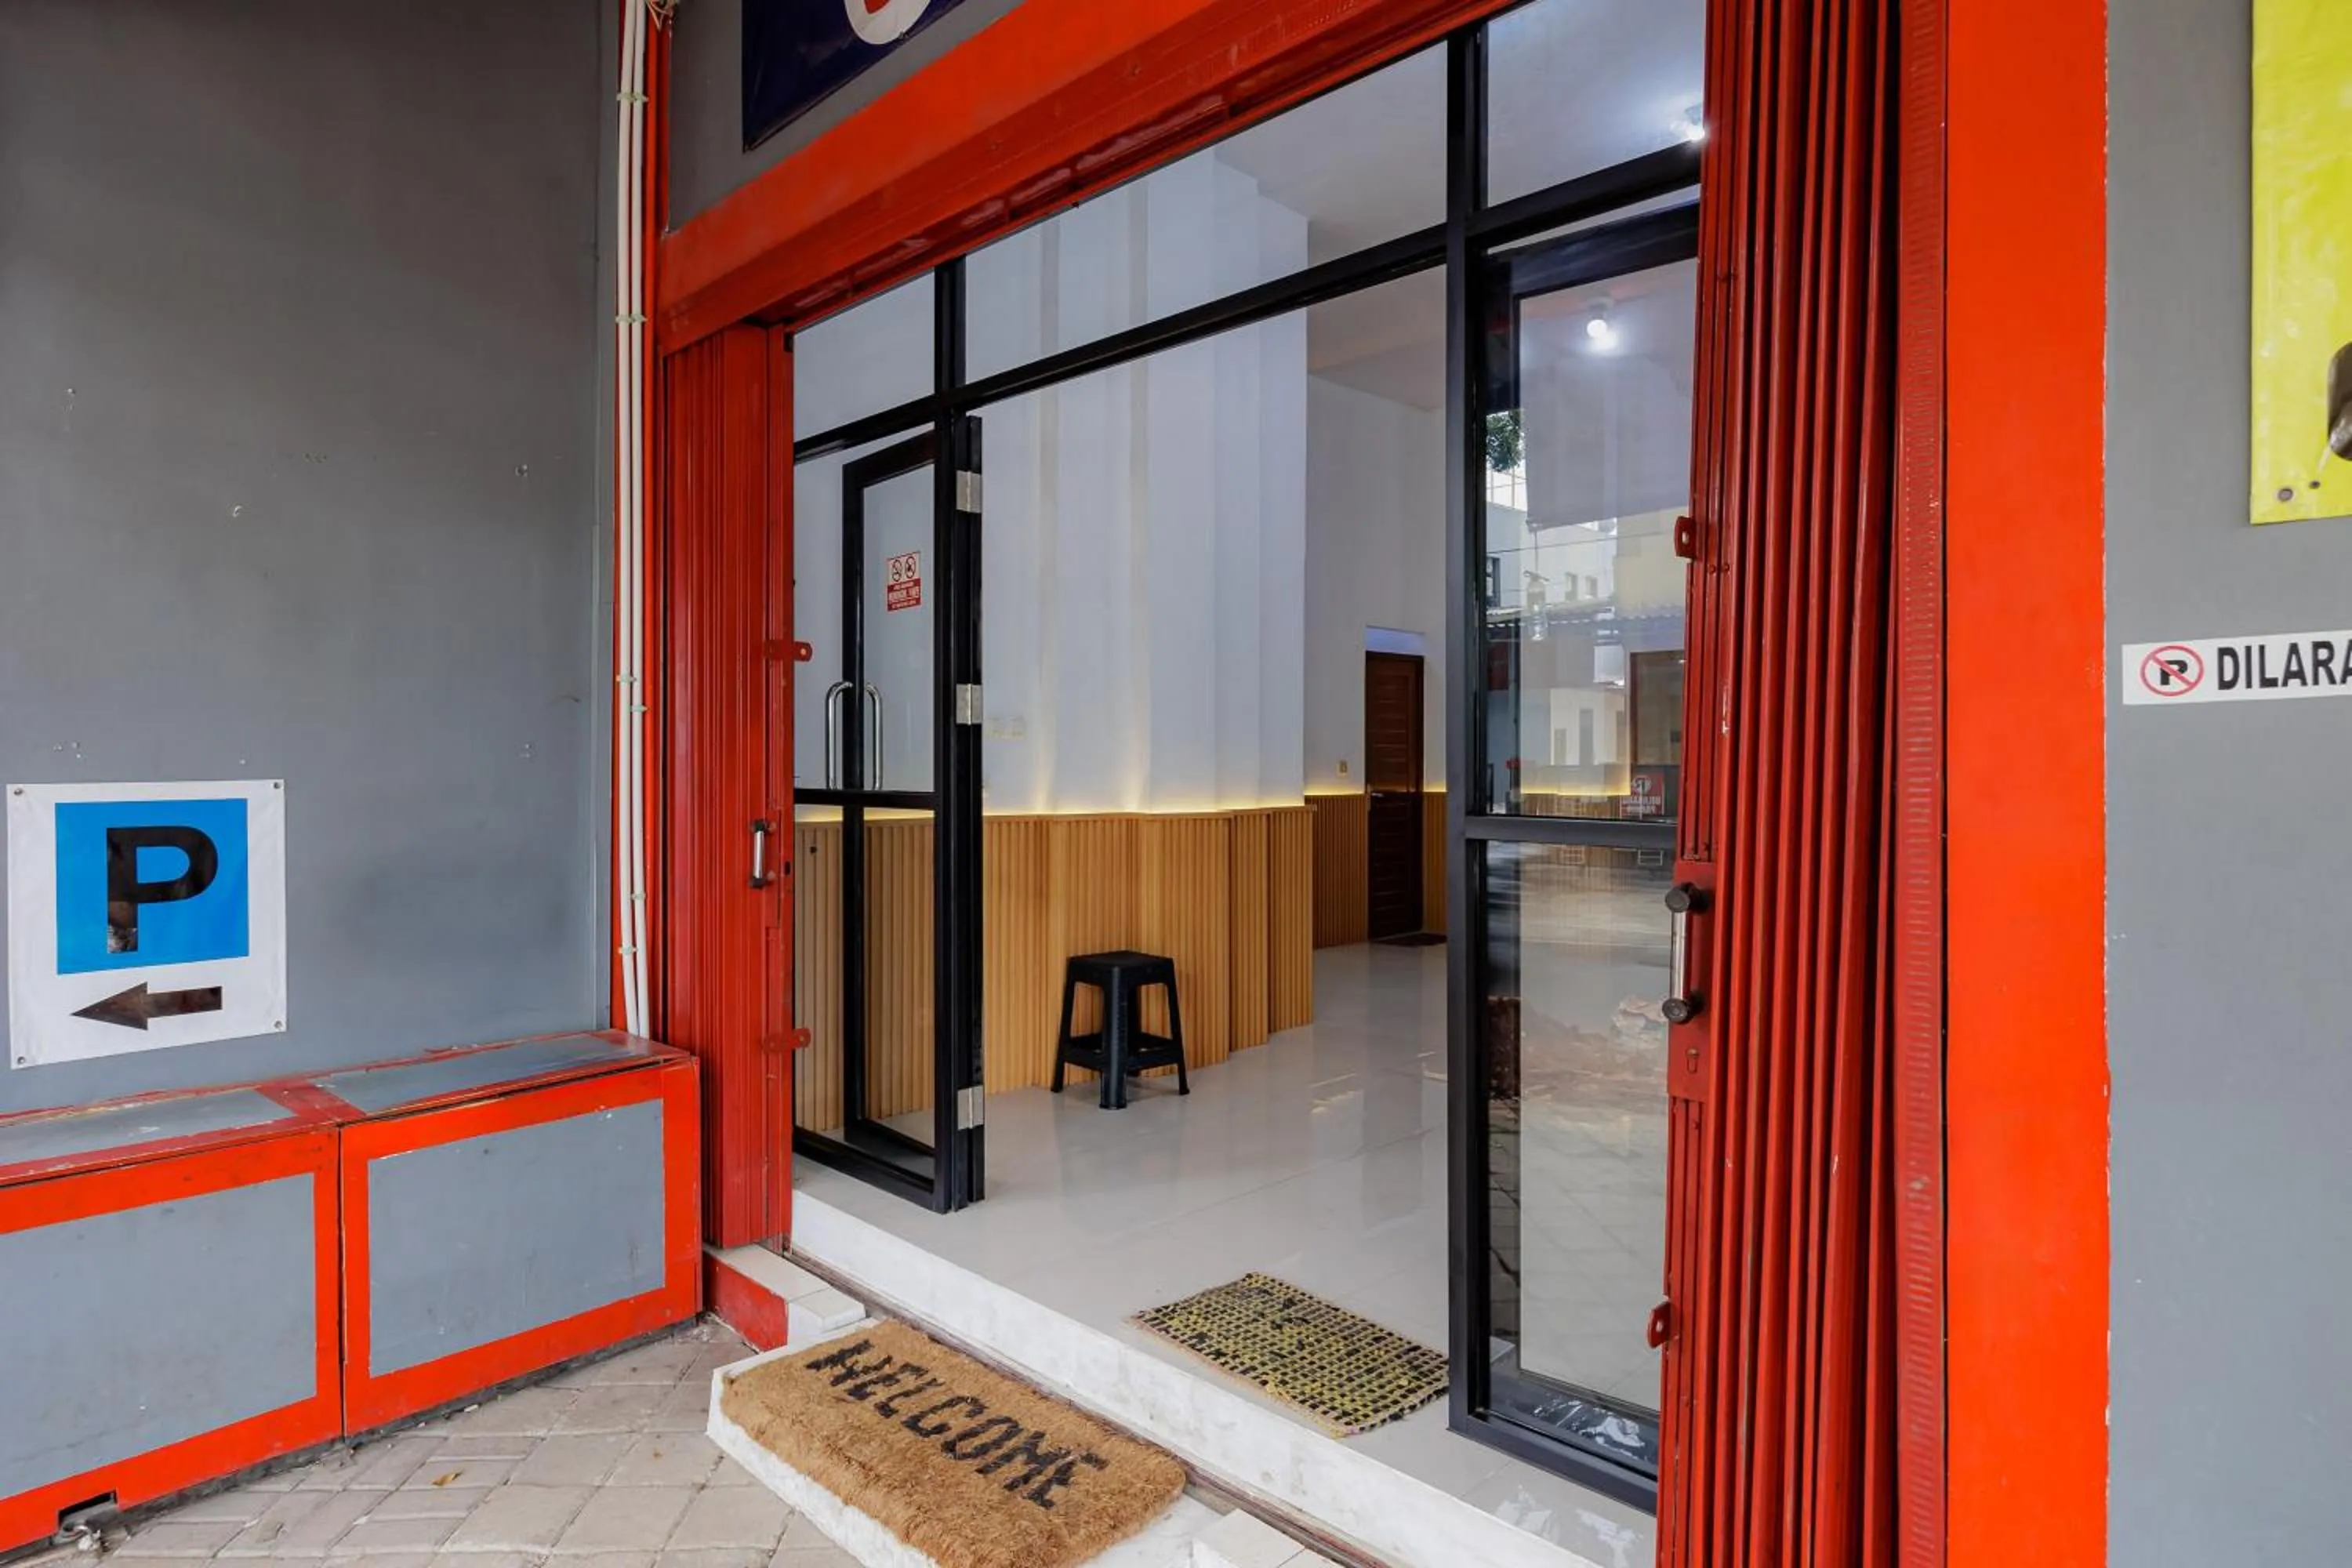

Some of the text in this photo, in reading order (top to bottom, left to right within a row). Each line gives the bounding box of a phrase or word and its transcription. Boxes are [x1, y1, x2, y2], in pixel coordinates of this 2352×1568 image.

[2160, 659, 2188, 686] P
[107, 826, 218, 953] P
[805, 1339, 1110, 1510] WELCOME
